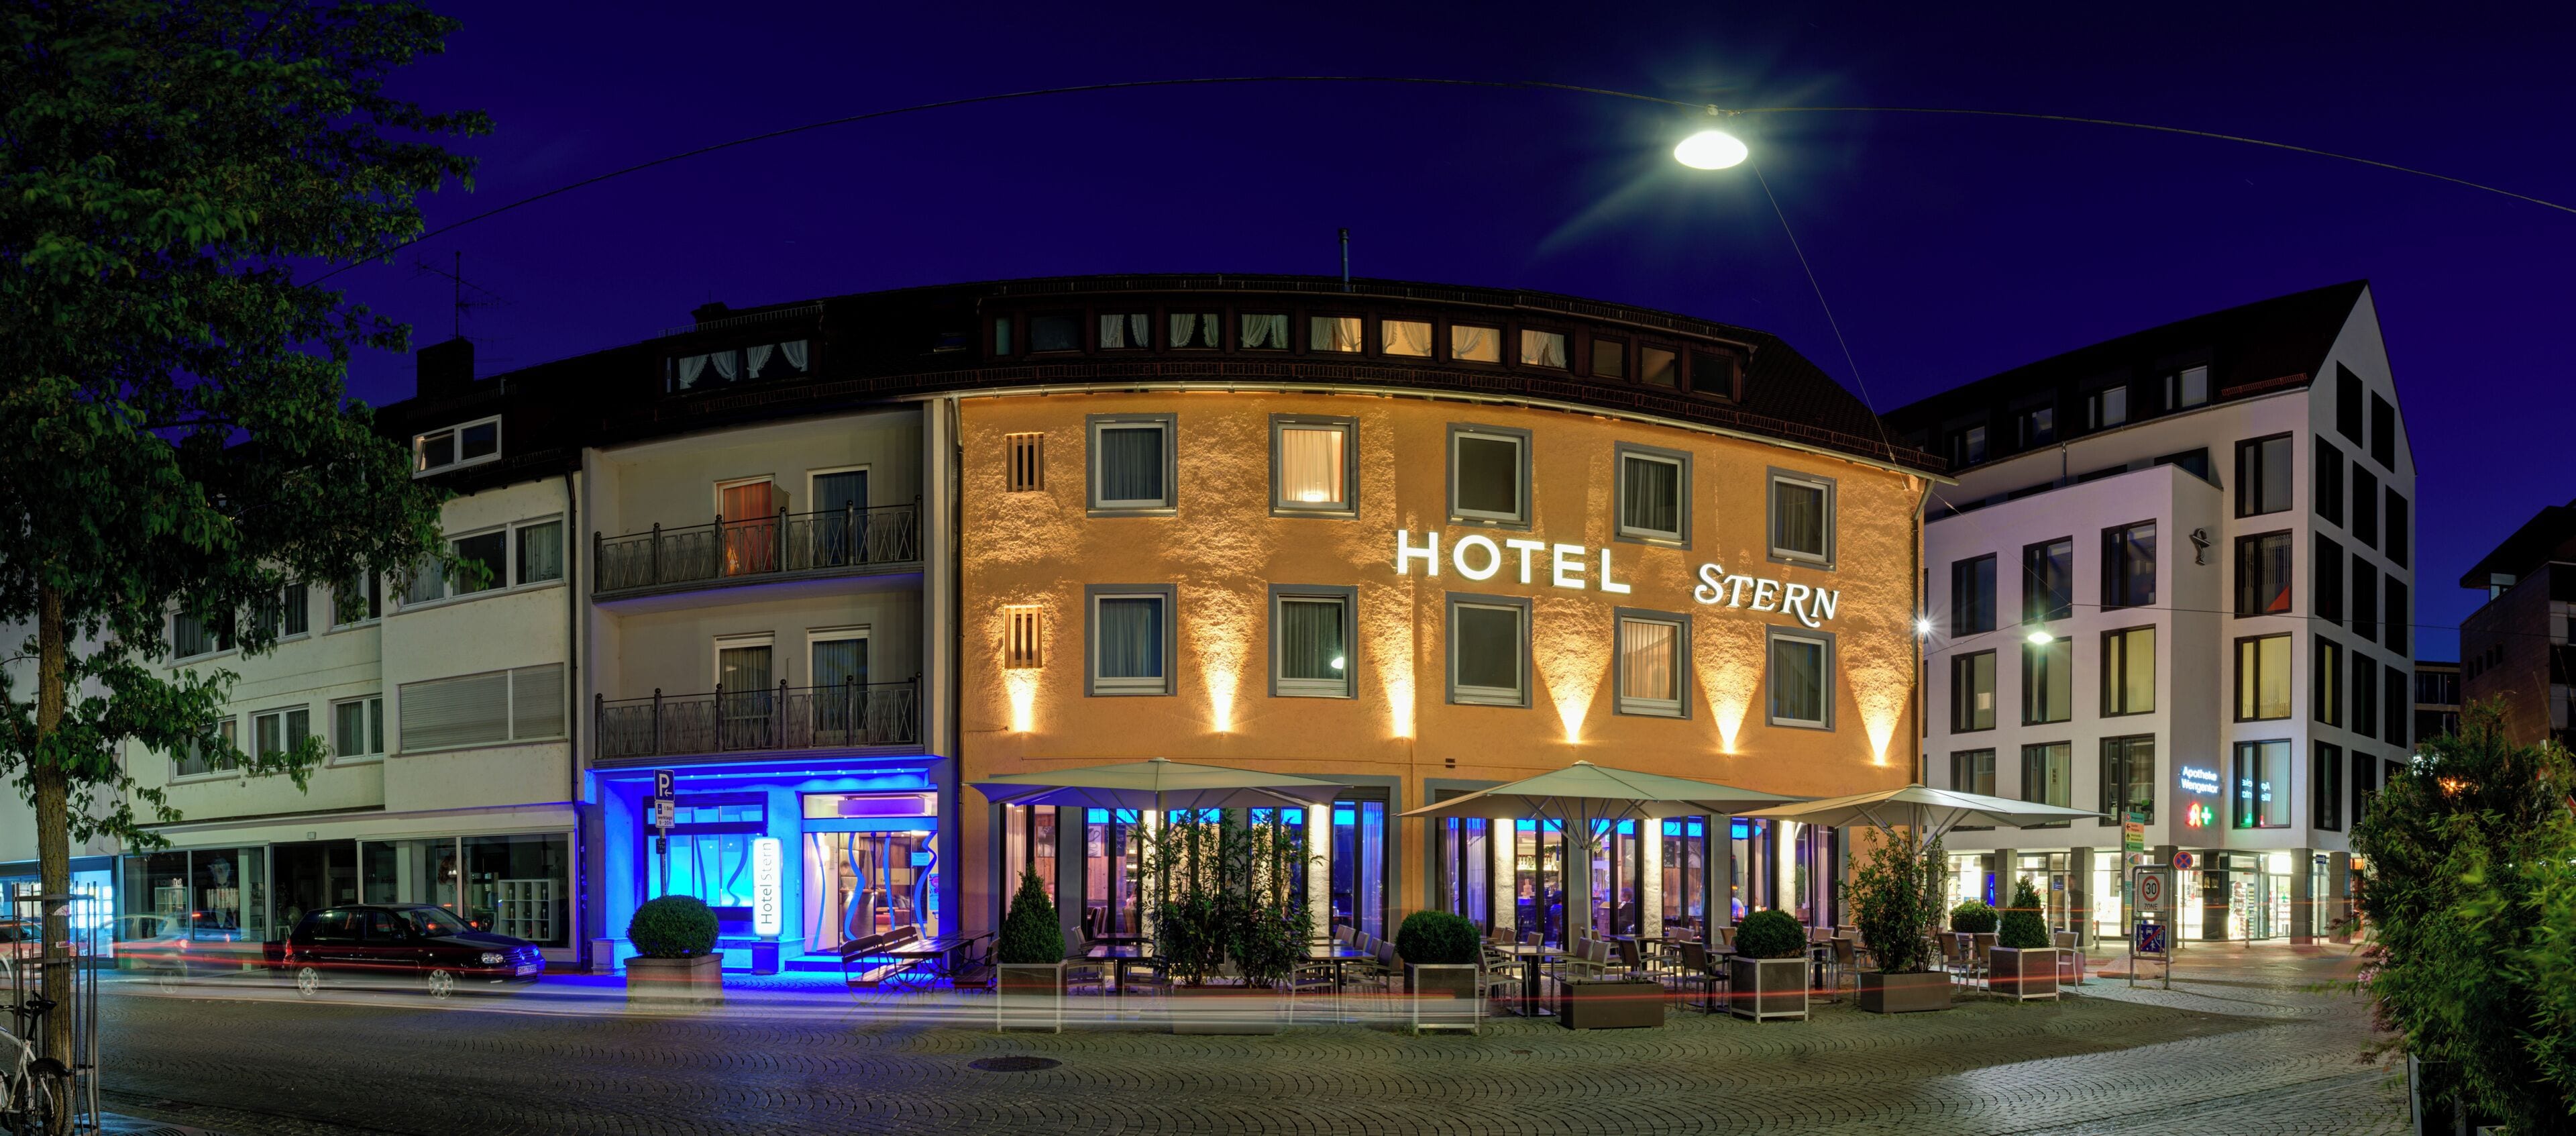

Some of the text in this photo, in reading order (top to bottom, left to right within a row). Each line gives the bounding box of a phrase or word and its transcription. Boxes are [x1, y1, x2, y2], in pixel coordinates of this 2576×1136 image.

[1397, 529, 1631, 594] HOTEL
[1693, 564, 1840, 628] STERN
[659, 773, 670, 797] P
[2181, 778, 2218, 794] Wengentor
[2182, 766, 2217, 782] Apotheke
[759, 842, 772, 924] Hotel Stern
[2145, 882, 2157, 894] 30
